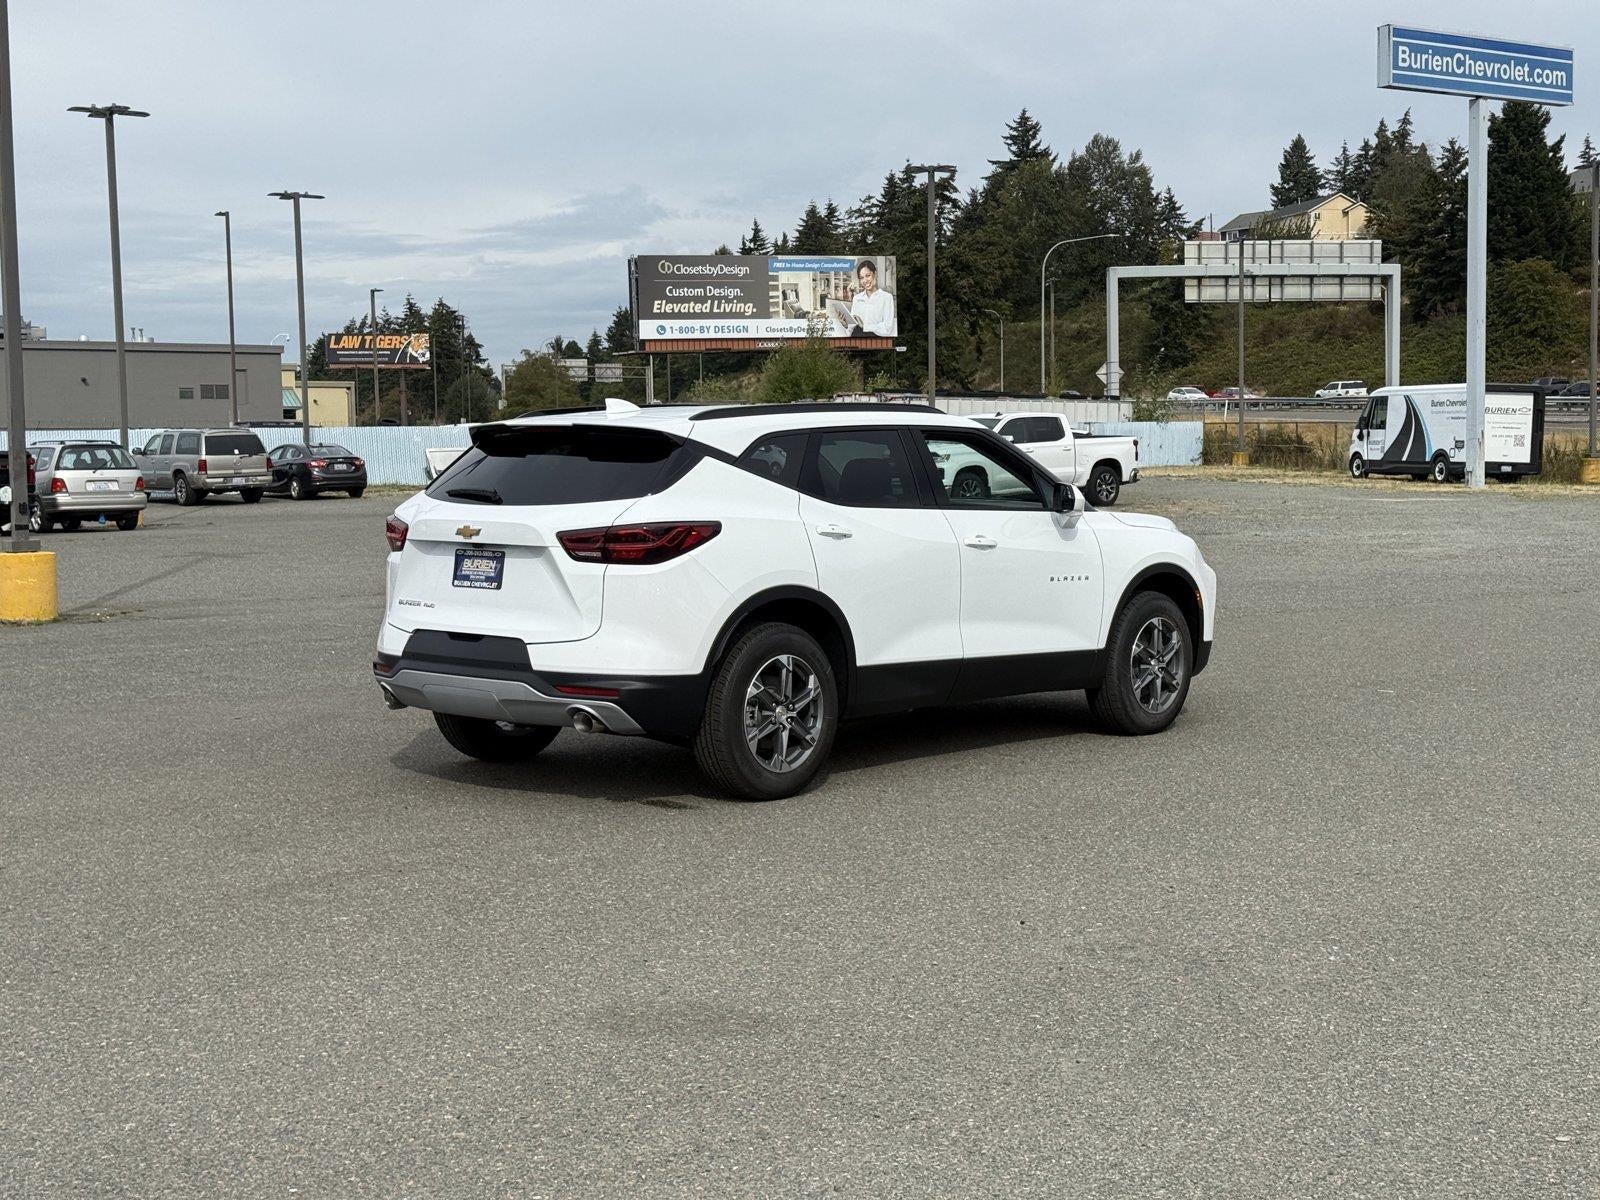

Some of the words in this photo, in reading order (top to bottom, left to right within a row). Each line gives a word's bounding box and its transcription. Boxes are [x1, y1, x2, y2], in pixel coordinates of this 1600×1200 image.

[1398, 45, 1566, 86] BurienChevrolet.com
[674, 264, 750, 276] ClosetsbyDesign
[666, 286, 704, 297] Custom
[706, 286, 744, 299] Design.
[653, 300, 711, 313] Elevated
[713, 300, 757, 315] Living.
[669, 326, 711, 334] 1-800-BY
[714, 325, 749, 334] DESIGN
[330, 336, 362, 348] LAW
[463, 559, 496, 570] BURIEN
